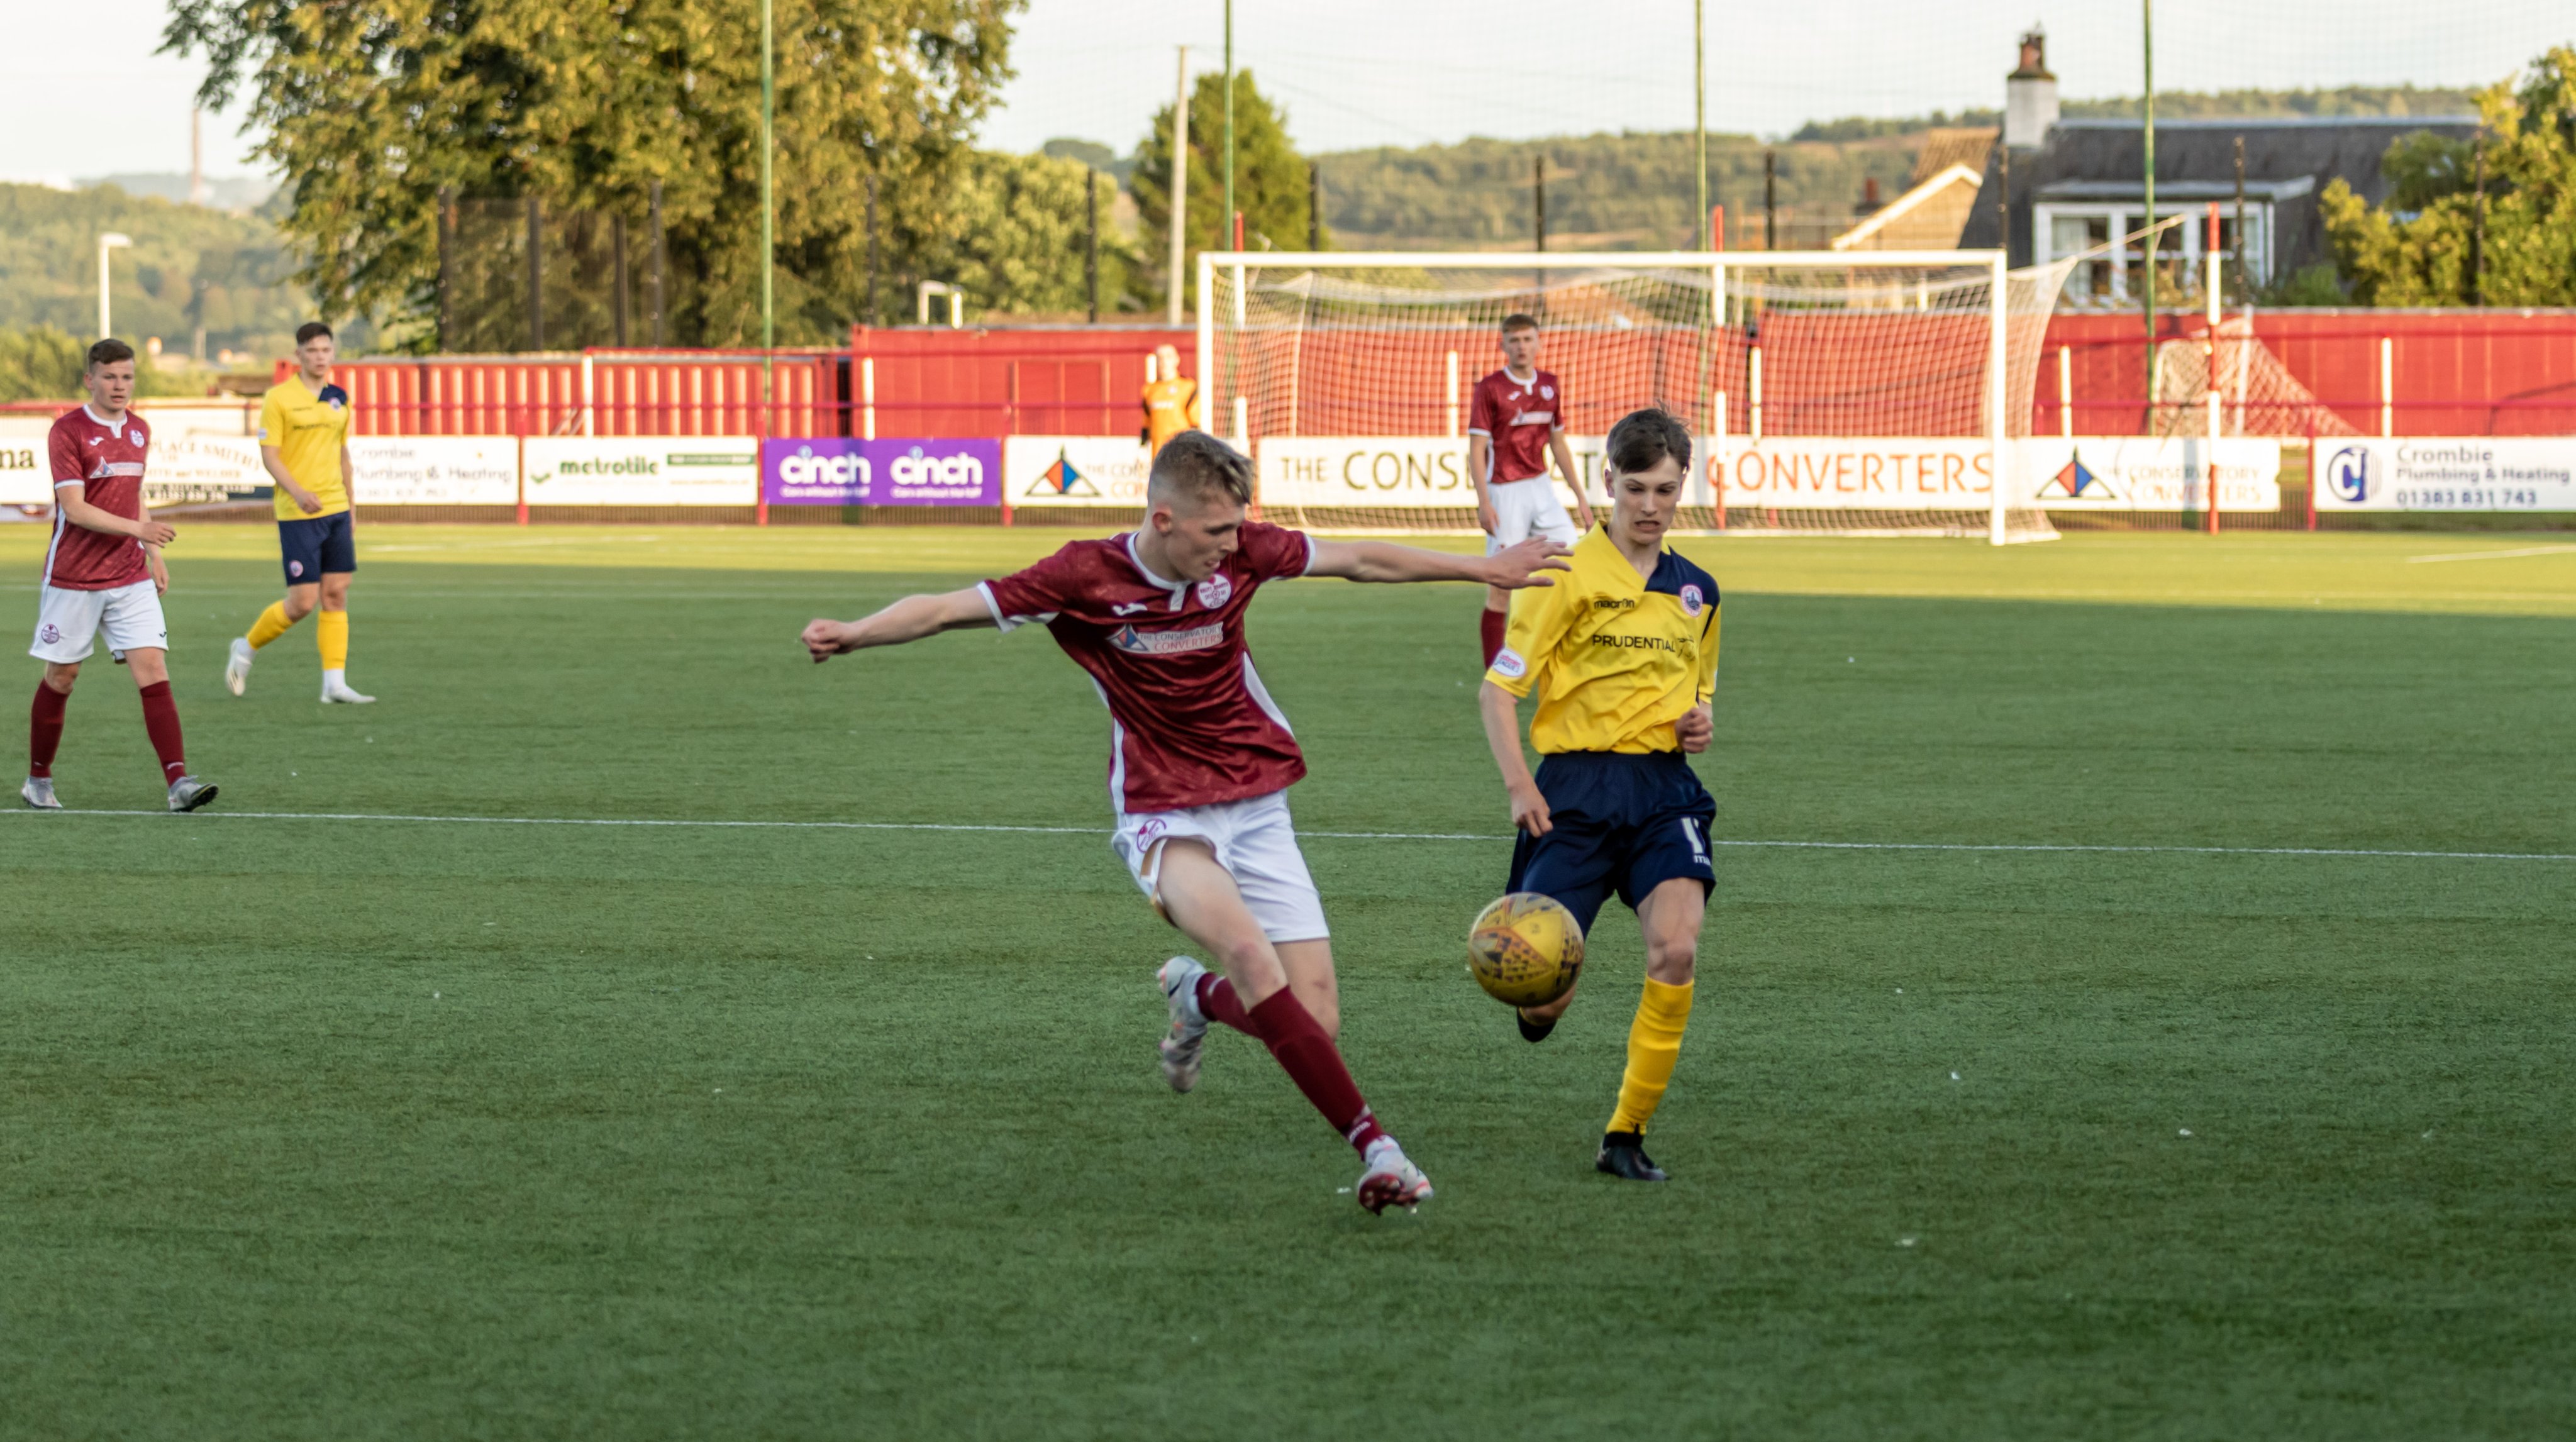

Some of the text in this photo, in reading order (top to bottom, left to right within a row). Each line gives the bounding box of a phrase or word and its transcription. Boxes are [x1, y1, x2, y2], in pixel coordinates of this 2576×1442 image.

[2397, 446, 2494, 463] Crombie
[560, 456, 659, 475] metrotile
[779, 445, 871, 484] cinch
[890, 446, 983, 485] cinch
[1280, 456, 1328, 482] THE
[1706, 451, 1992, 493] CONVERTERS
[448, 466, 512, 485] Heating
[2397, 467, 2570, 484] Plumbing & Heating
[2397, 488, 2536, 504] 01383 831 743
[1155, 624, 1222, 640] CONSERVATORY
[1155, 634, 1221, 652] CONVERTERS
[1592, 634, 1676, 653] PRUDENTIAL
